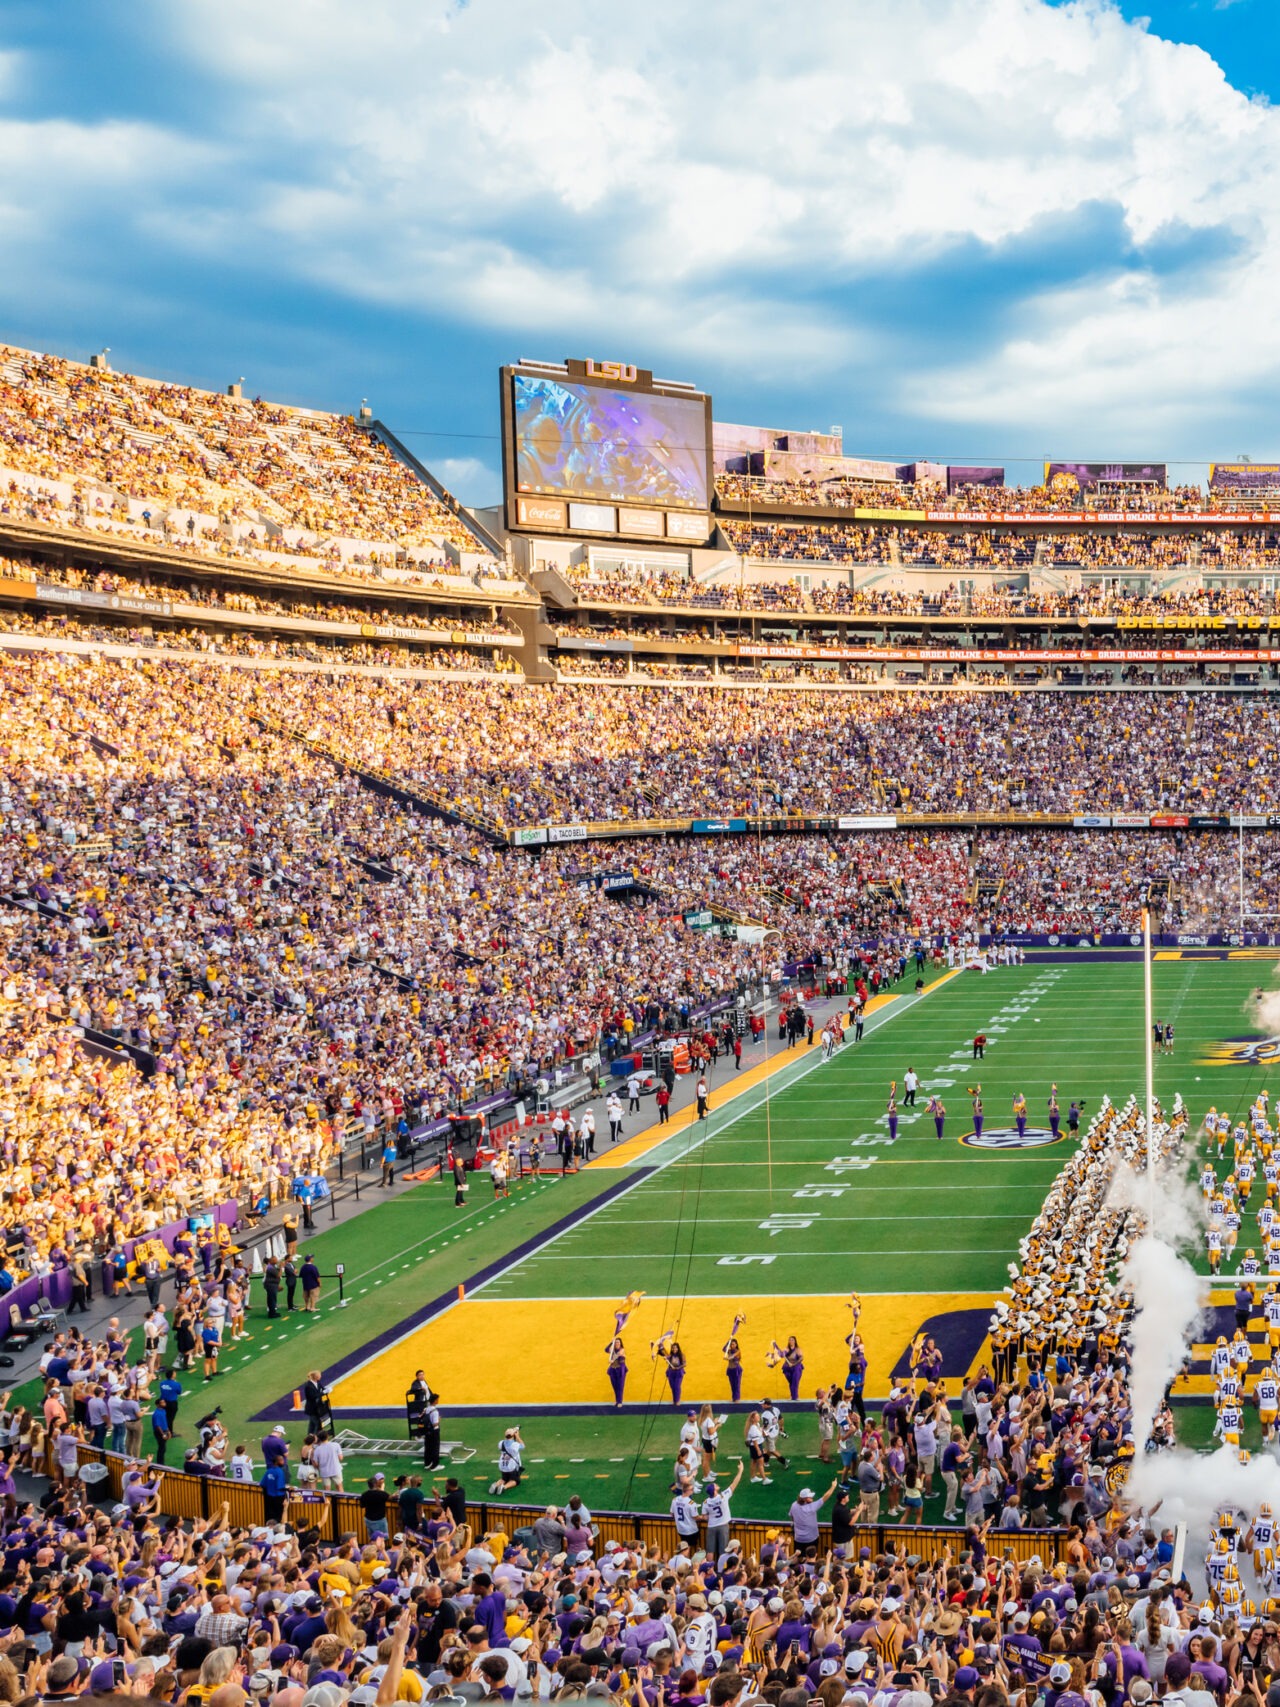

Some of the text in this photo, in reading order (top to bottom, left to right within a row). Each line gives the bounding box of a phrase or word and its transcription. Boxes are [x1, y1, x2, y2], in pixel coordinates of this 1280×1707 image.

[585, 358, 637, 383] LSU
[928, 512, 987, 520] ORDER ONLINE
[1098, 513, 1124, 521] ORDER
[1117, 616, 1226, 629] WELCOME
[1235, 616, 1261, 628] TO
[740, 646, 803, 656] ORDER ONLINE
[920, 651, 981, 659] ORDER ONLINE
[559, 828, 585, 838] TACO BELL
[609, 876, 634, 887] Marathon
[824, 1156, 879, 1170] 20
[1240, 1168, 1250, 1177] 67
[1266, 1170, 1276, 1179] 34
[1205, 1175, 1211, 1184] 2
[792, 1183, 851, 1197] 15
[758, 1212, 821, 1229] 10
[1263, 1213, 1272, 1222] 16
[1270, 1228, 1280, 1238] 42
[716, 1255, 777, 1265] 5
[1269, 1254, 1280, 1264] 79
[1244, 1263, 1256, 1273] 26
[1269, 1308, 1279, 1319] 71
[1236, 1346, 1248, 1357] 47
[1217, 1353, 1229, 1364] 14
[1222, 1383, 1236, 1395] 40
[1261, 1386, 1275, 1399] 68
[1223, 1415, 1237, 1427] 82
[236, 1467, 243, 1478] 9
[677, 1507, 685, 1522] 9
[713, 1505, 723, 1518] 3
[1255, 1527, 1271, 1543] 49
[1210, 1564, 1225, 1580] 75
[690, 1636, 696, 1644] 9
[1020, 1647, 1038, 1660] GEAUX
